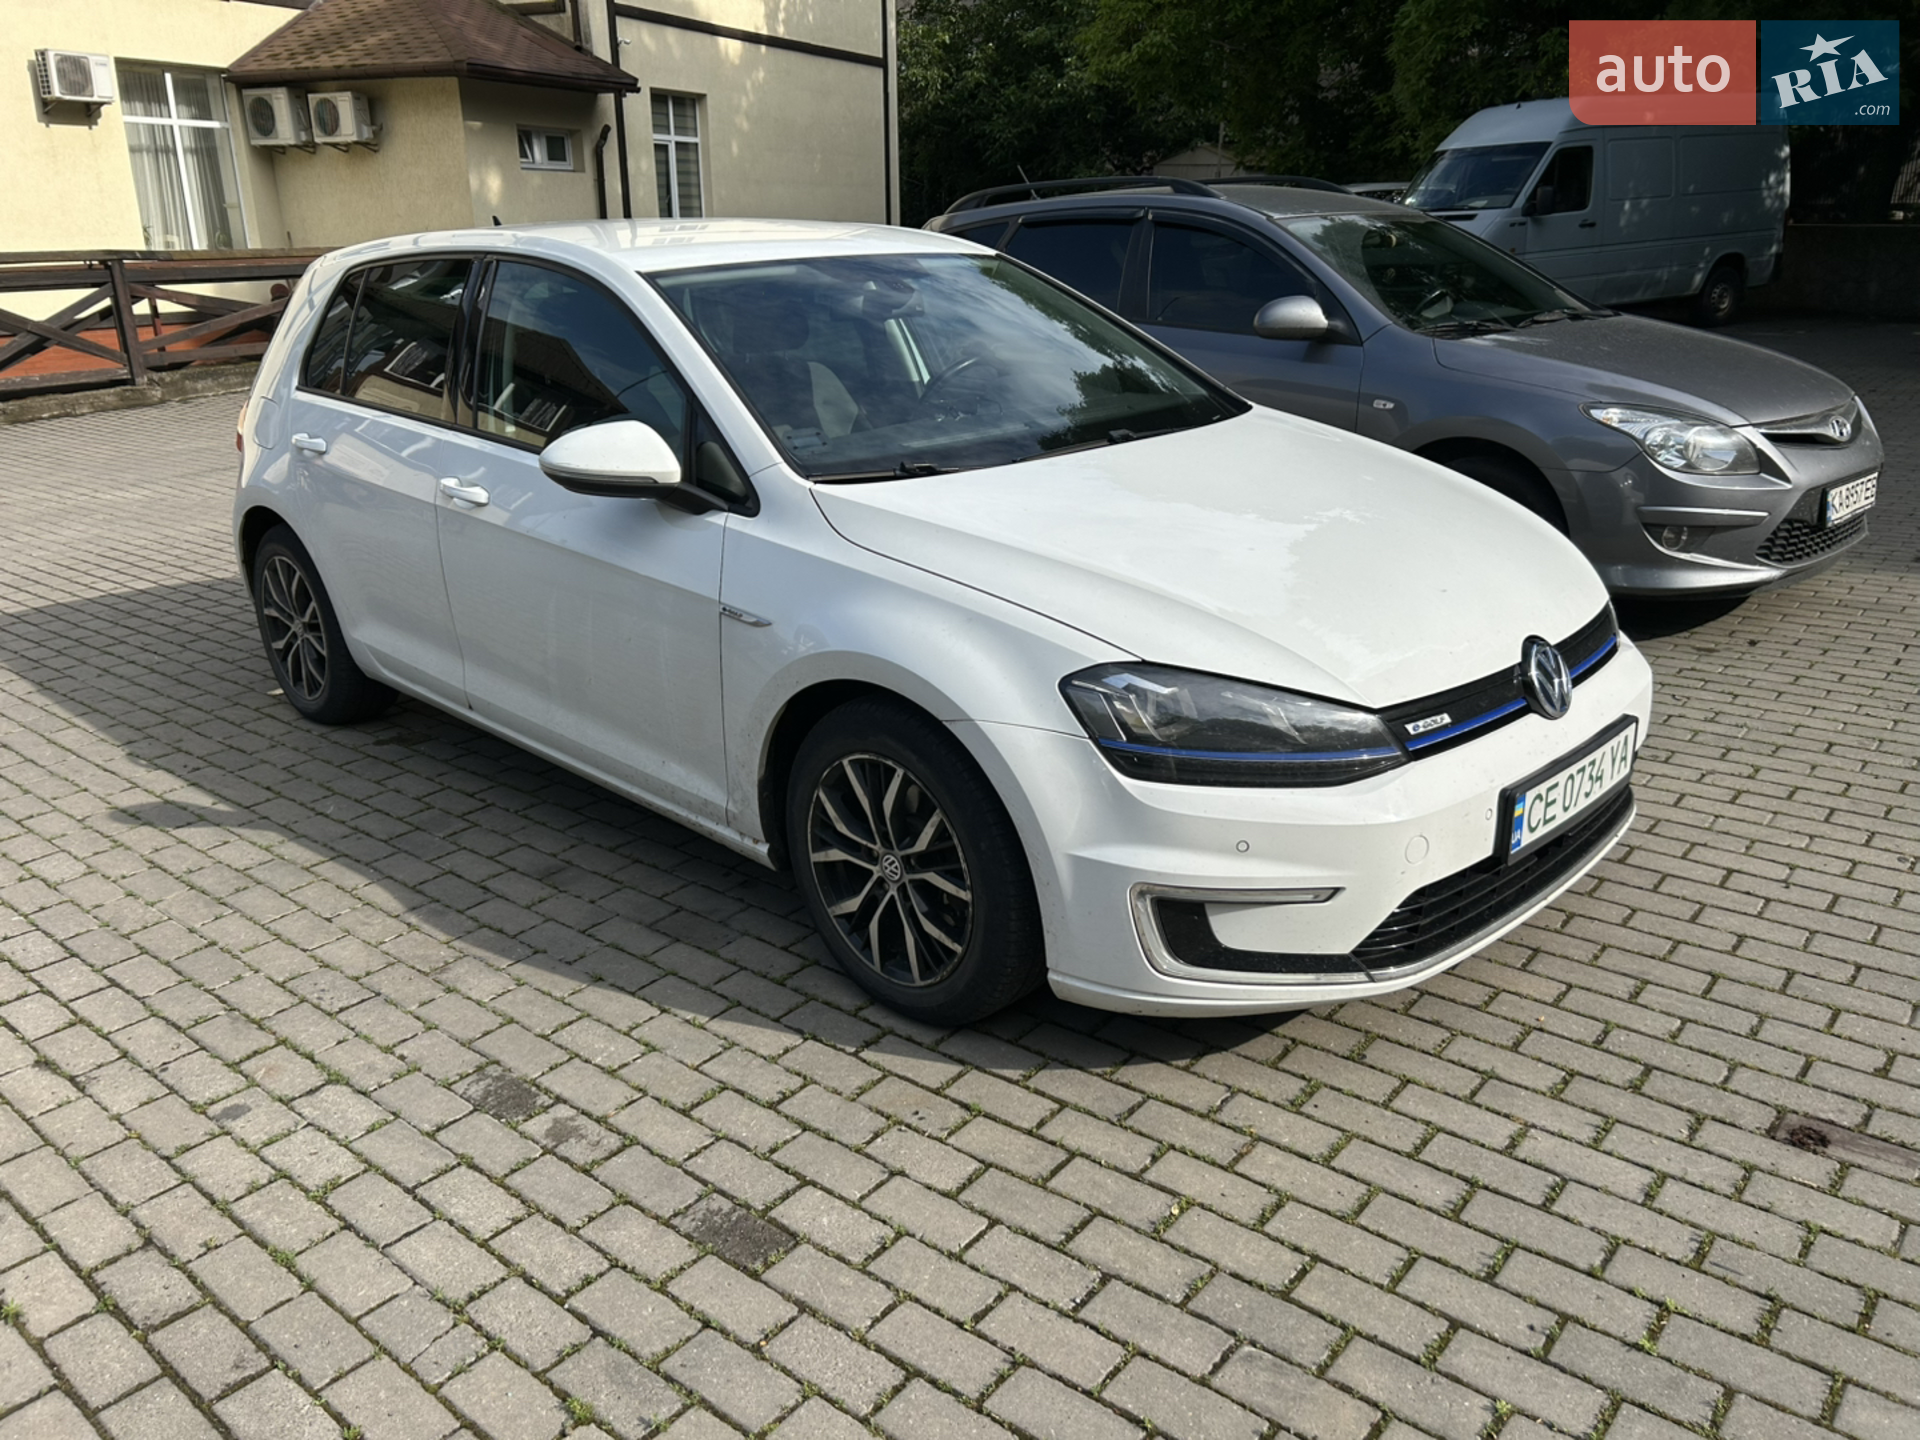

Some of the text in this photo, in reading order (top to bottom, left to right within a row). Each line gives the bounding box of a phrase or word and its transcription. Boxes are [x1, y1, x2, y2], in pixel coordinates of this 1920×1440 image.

[1527, 734, 1629, 833] CE 0734 YA
